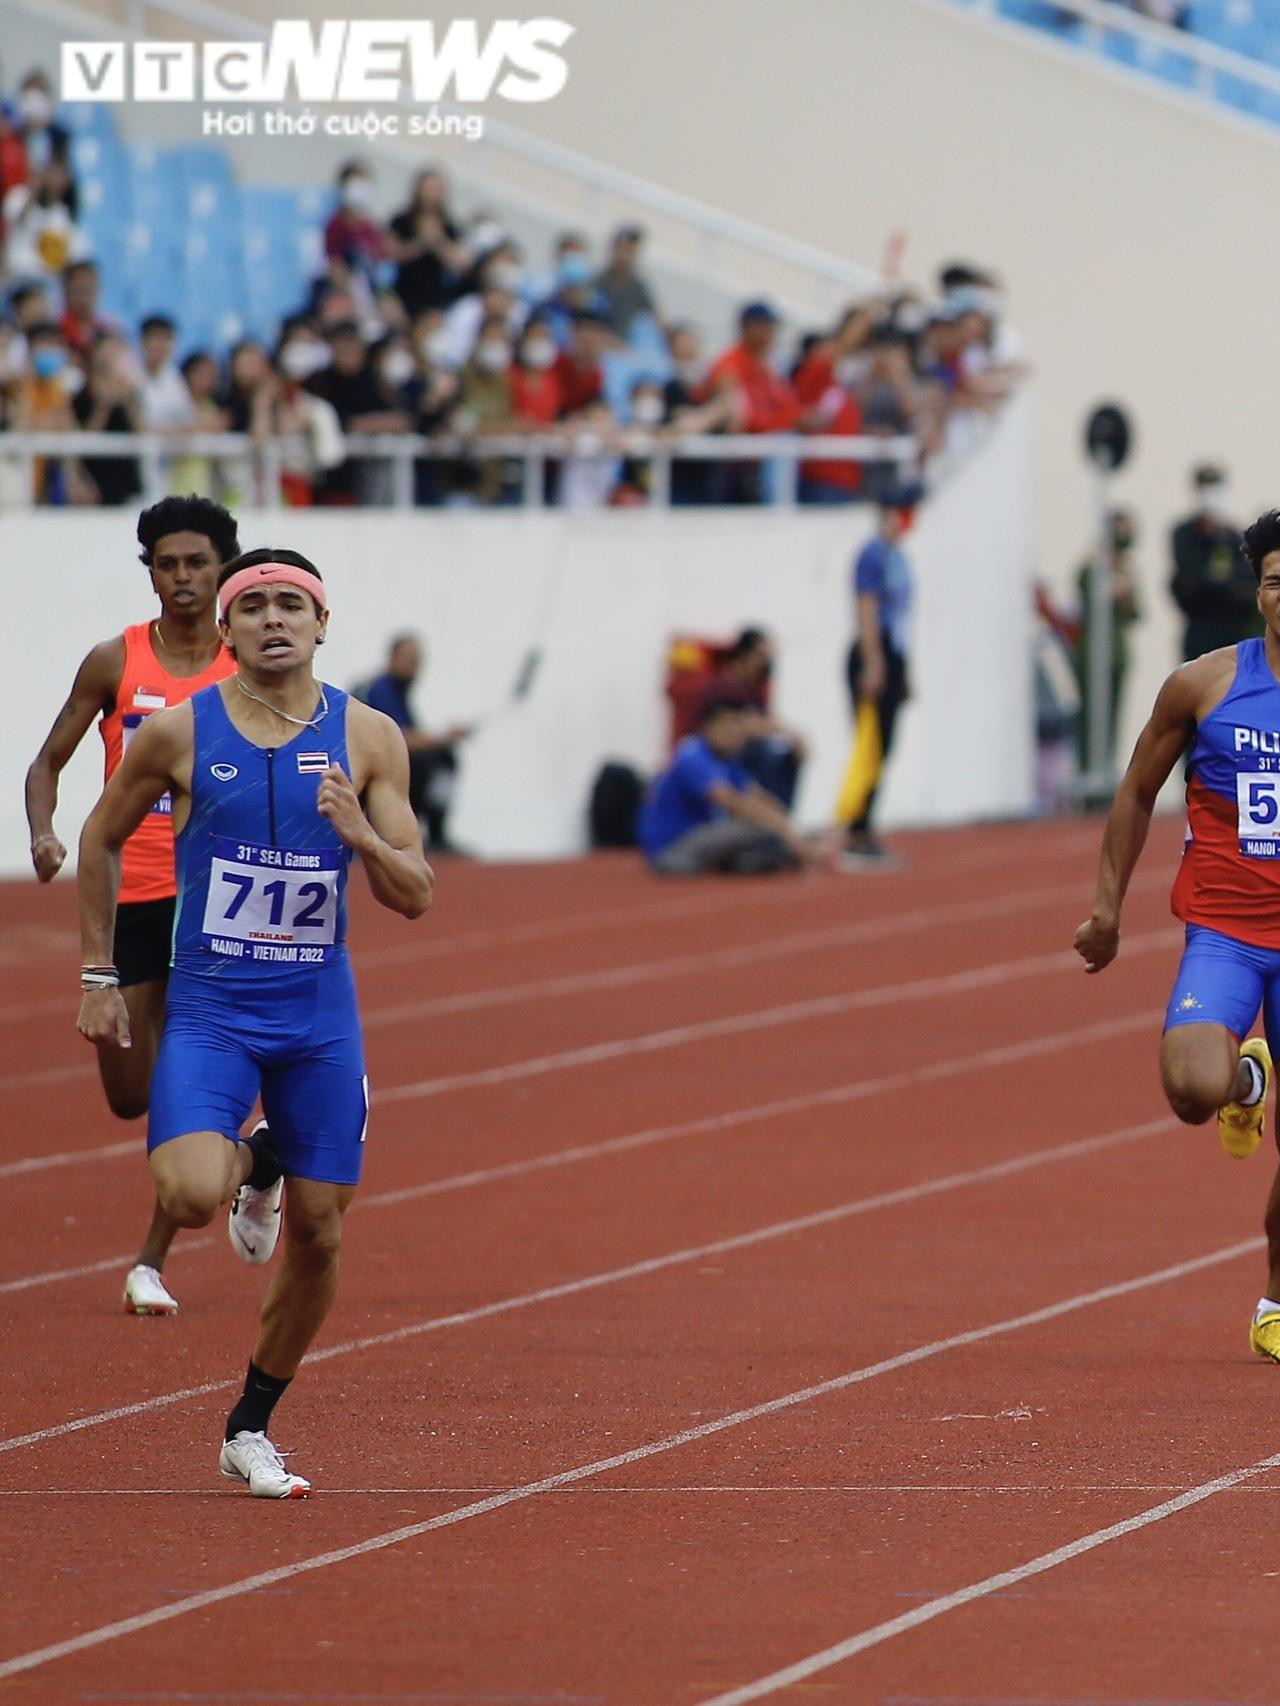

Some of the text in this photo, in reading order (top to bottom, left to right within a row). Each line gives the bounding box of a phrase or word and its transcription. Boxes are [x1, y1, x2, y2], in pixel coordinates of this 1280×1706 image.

[1247, 841, 1276, 856] HANOI
[260, 849, 282, 866] SEA
[285, 852, 321, 868] Games
[222, 871, 328, 928] 712
[249, 932, 293, 941] THAILAND
[211, 938, 244, 957] HANOI
[253, 945, 297, 962] VIETNAM
[299, 947, 324, 963] 2022
